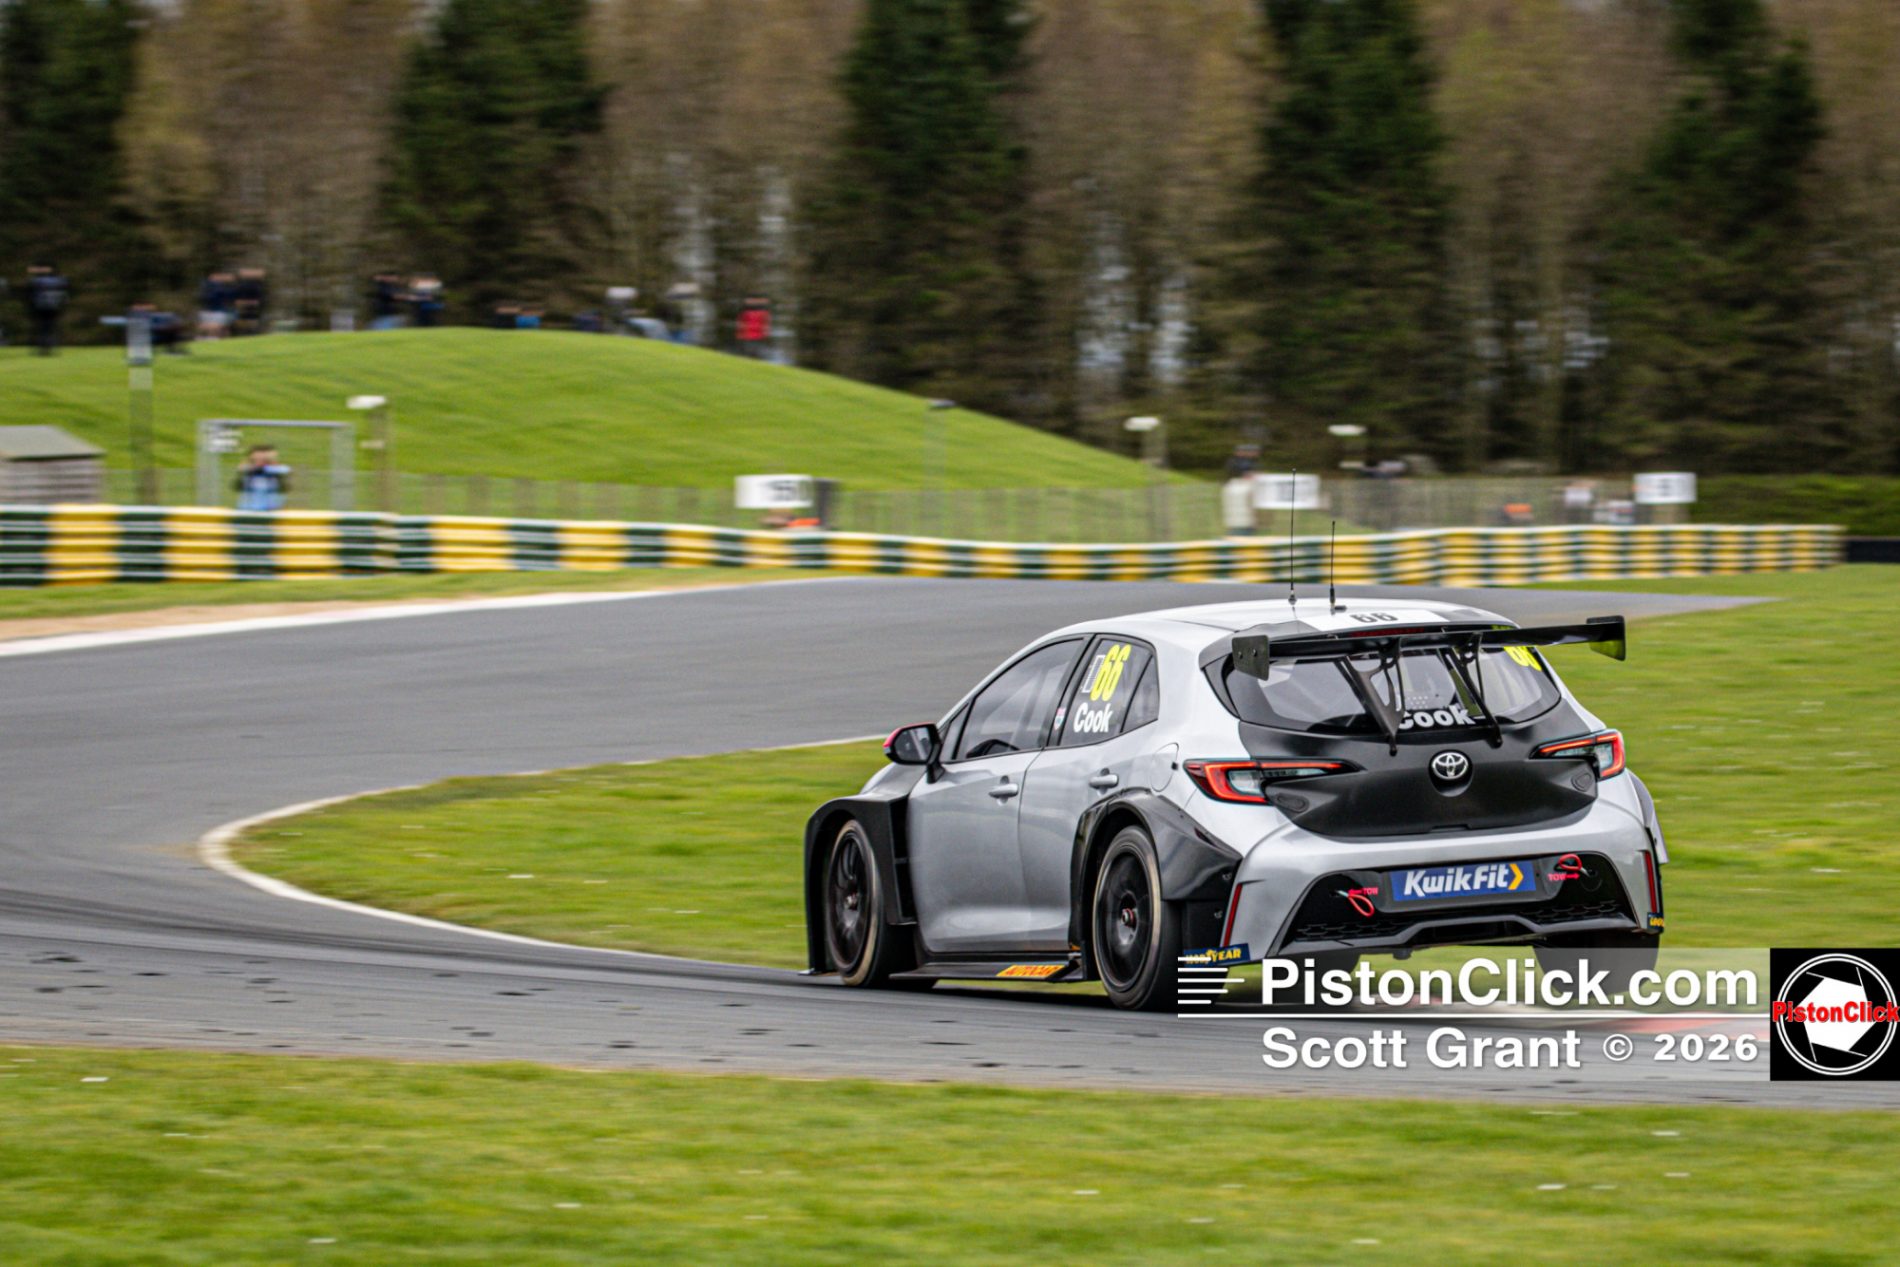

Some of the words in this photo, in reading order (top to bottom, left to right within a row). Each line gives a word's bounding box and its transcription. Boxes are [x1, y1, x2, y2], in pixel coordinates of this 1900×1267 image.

[1349, 611, 1399, 624] 66
[1089, 643, 1132, 702] 66
[1073, 701, 1114, 734] Cook
[1547, 873, 1567, 882] TOW
[1362, 887, 1379, 896] TOW
